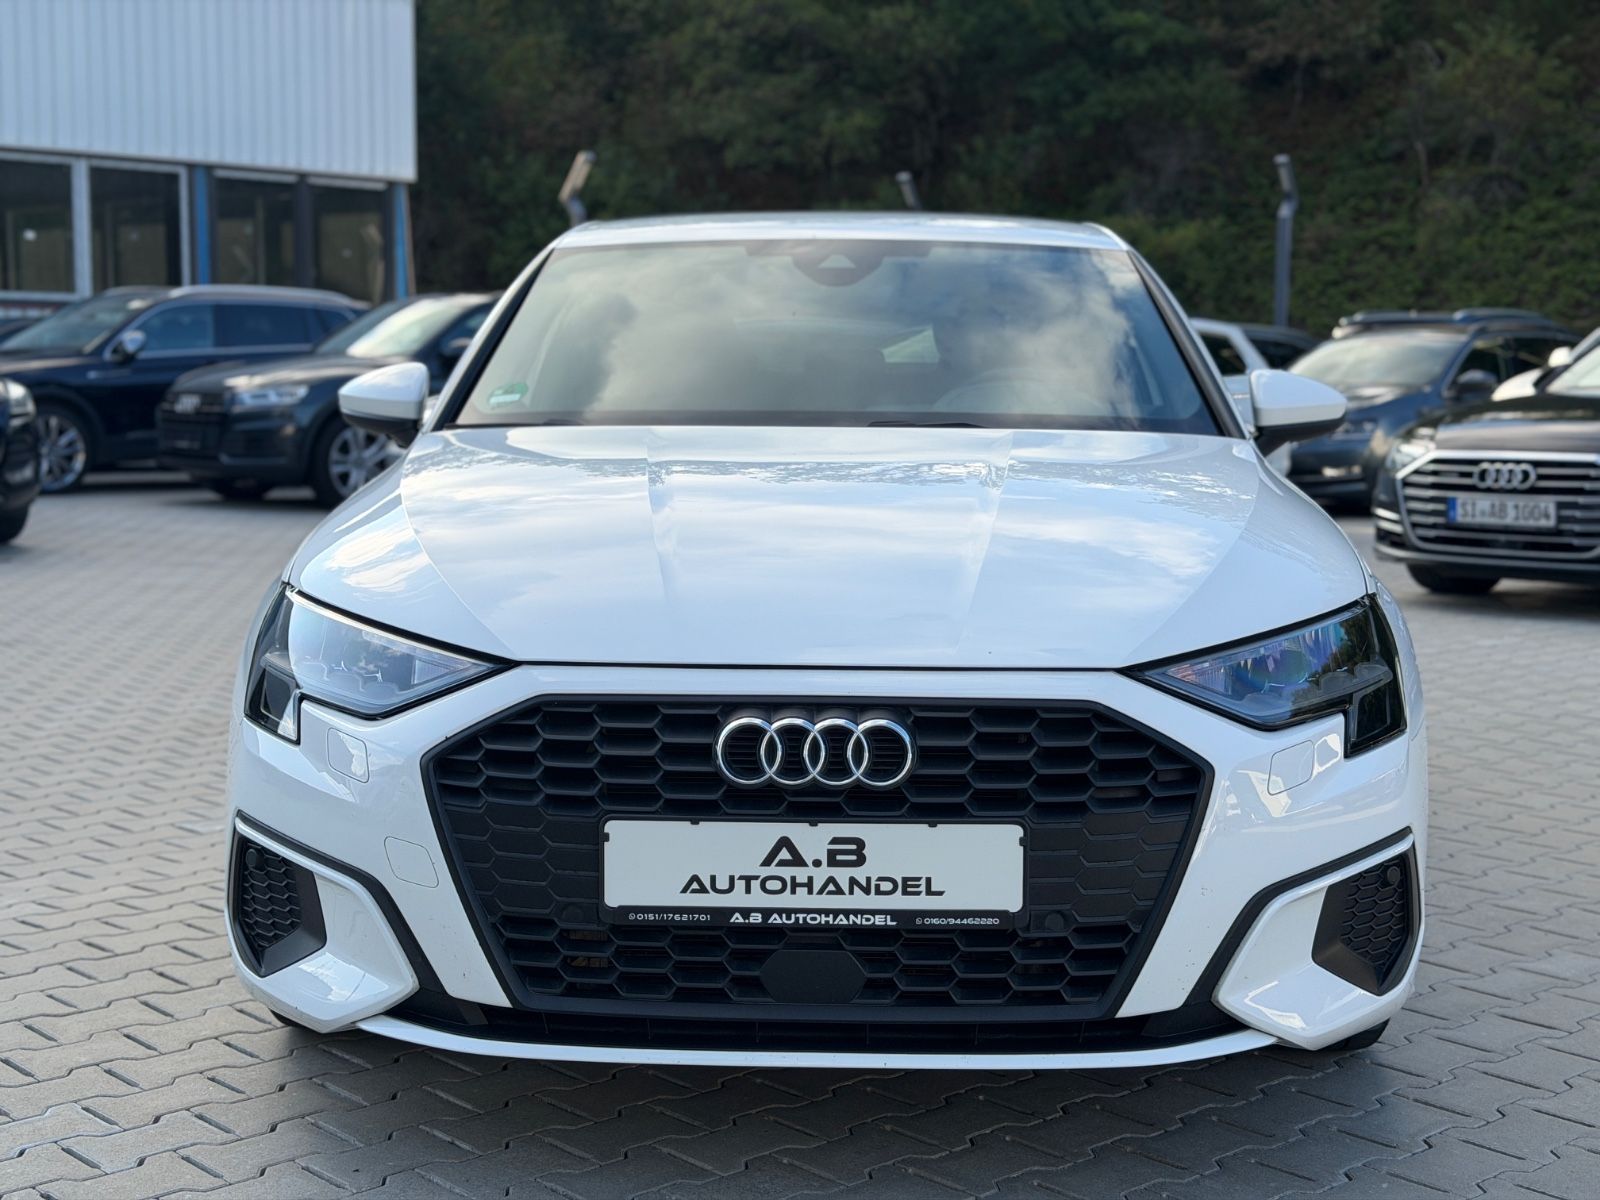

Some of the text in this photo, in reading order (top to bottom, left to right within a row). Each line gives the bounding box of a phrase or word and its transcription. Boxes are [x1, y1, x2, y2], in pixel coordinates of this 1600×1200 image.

[759, 835, 867, 868] A.B
[679, 873, 946, 897] AUTOHANDEL
[636, 913, 711, 921] 0151/17621701
[729, 912, 897, 926] A.B AUTOHANDEL
